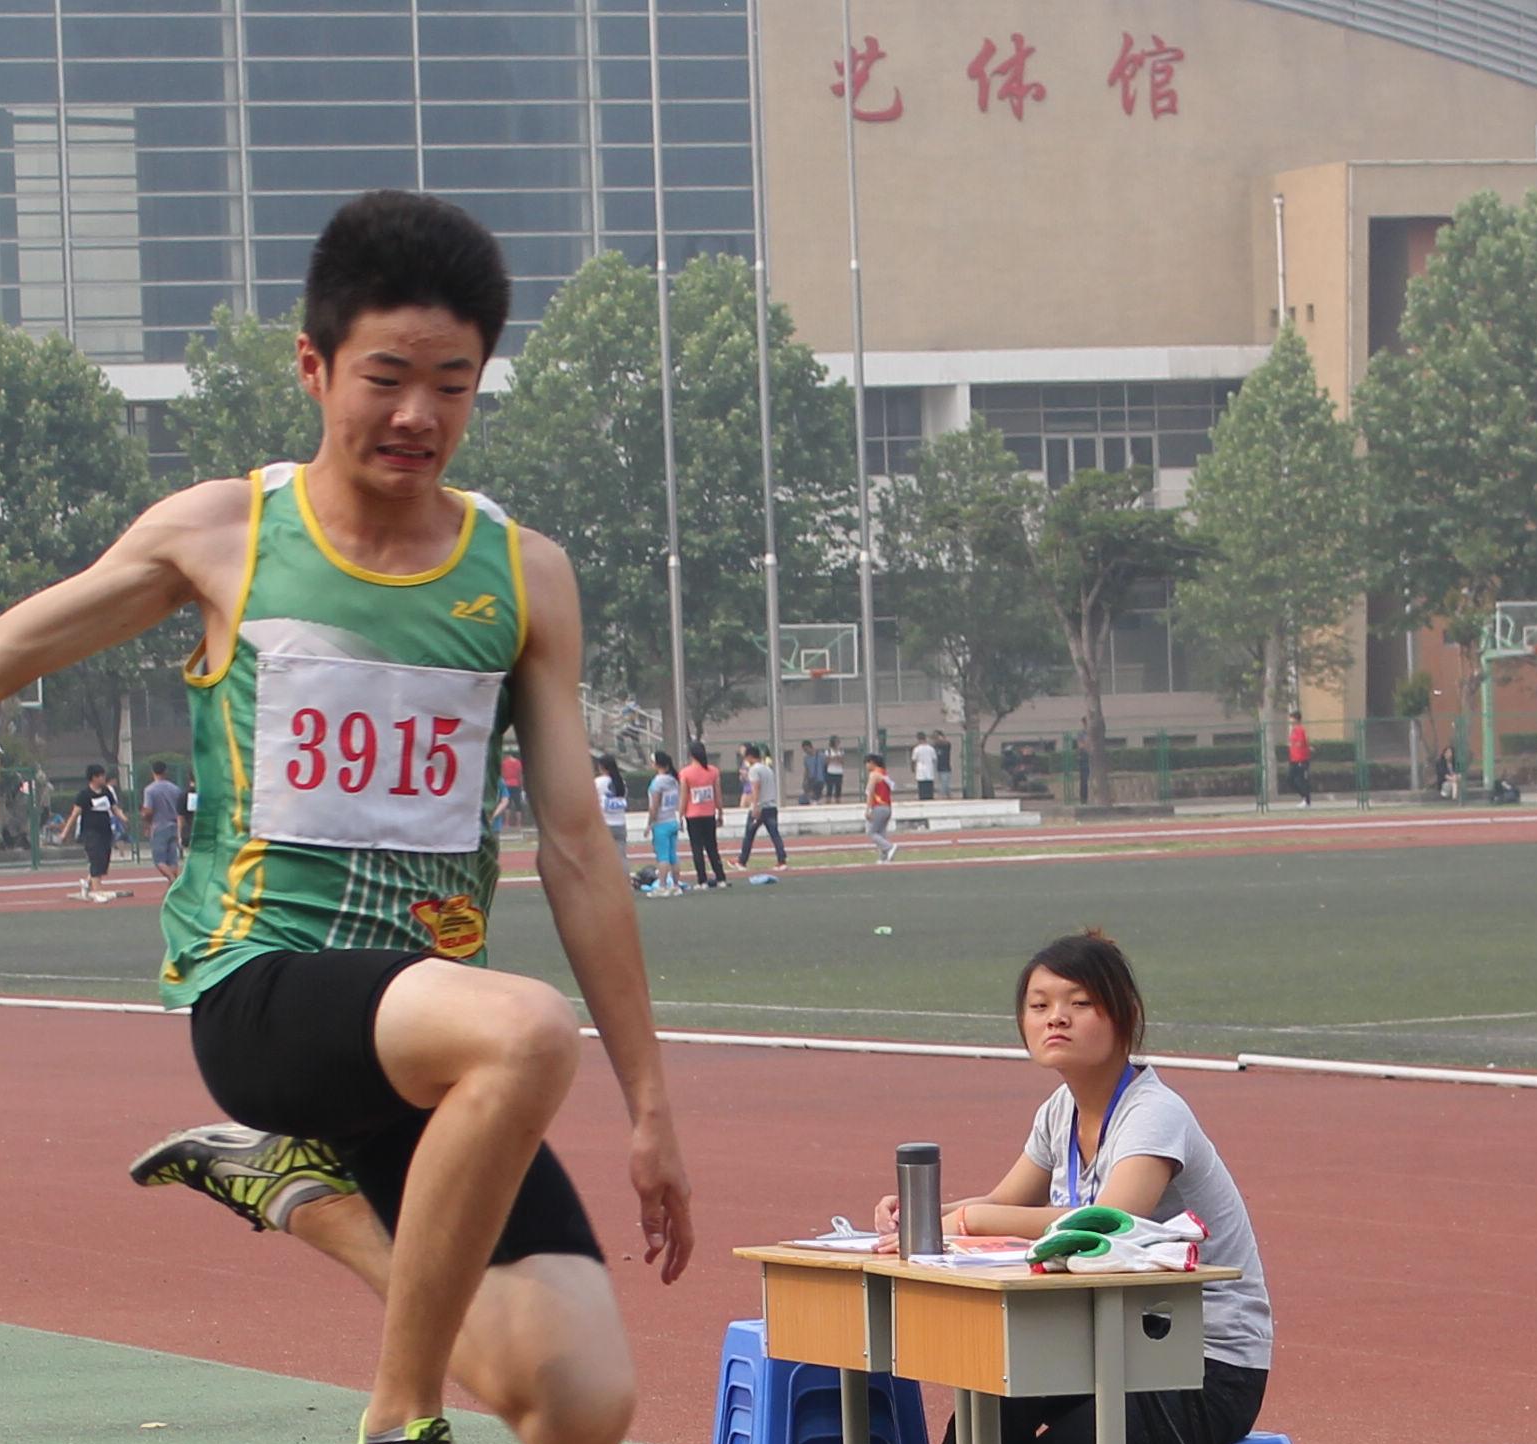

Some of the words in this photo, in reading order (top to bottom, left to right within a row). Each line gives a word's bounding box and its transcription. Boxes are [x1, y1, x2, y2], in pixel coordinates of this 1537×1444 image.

[830, 32, 1185, 122] 艺体馆
[286, 708, 461, 797] 3915
